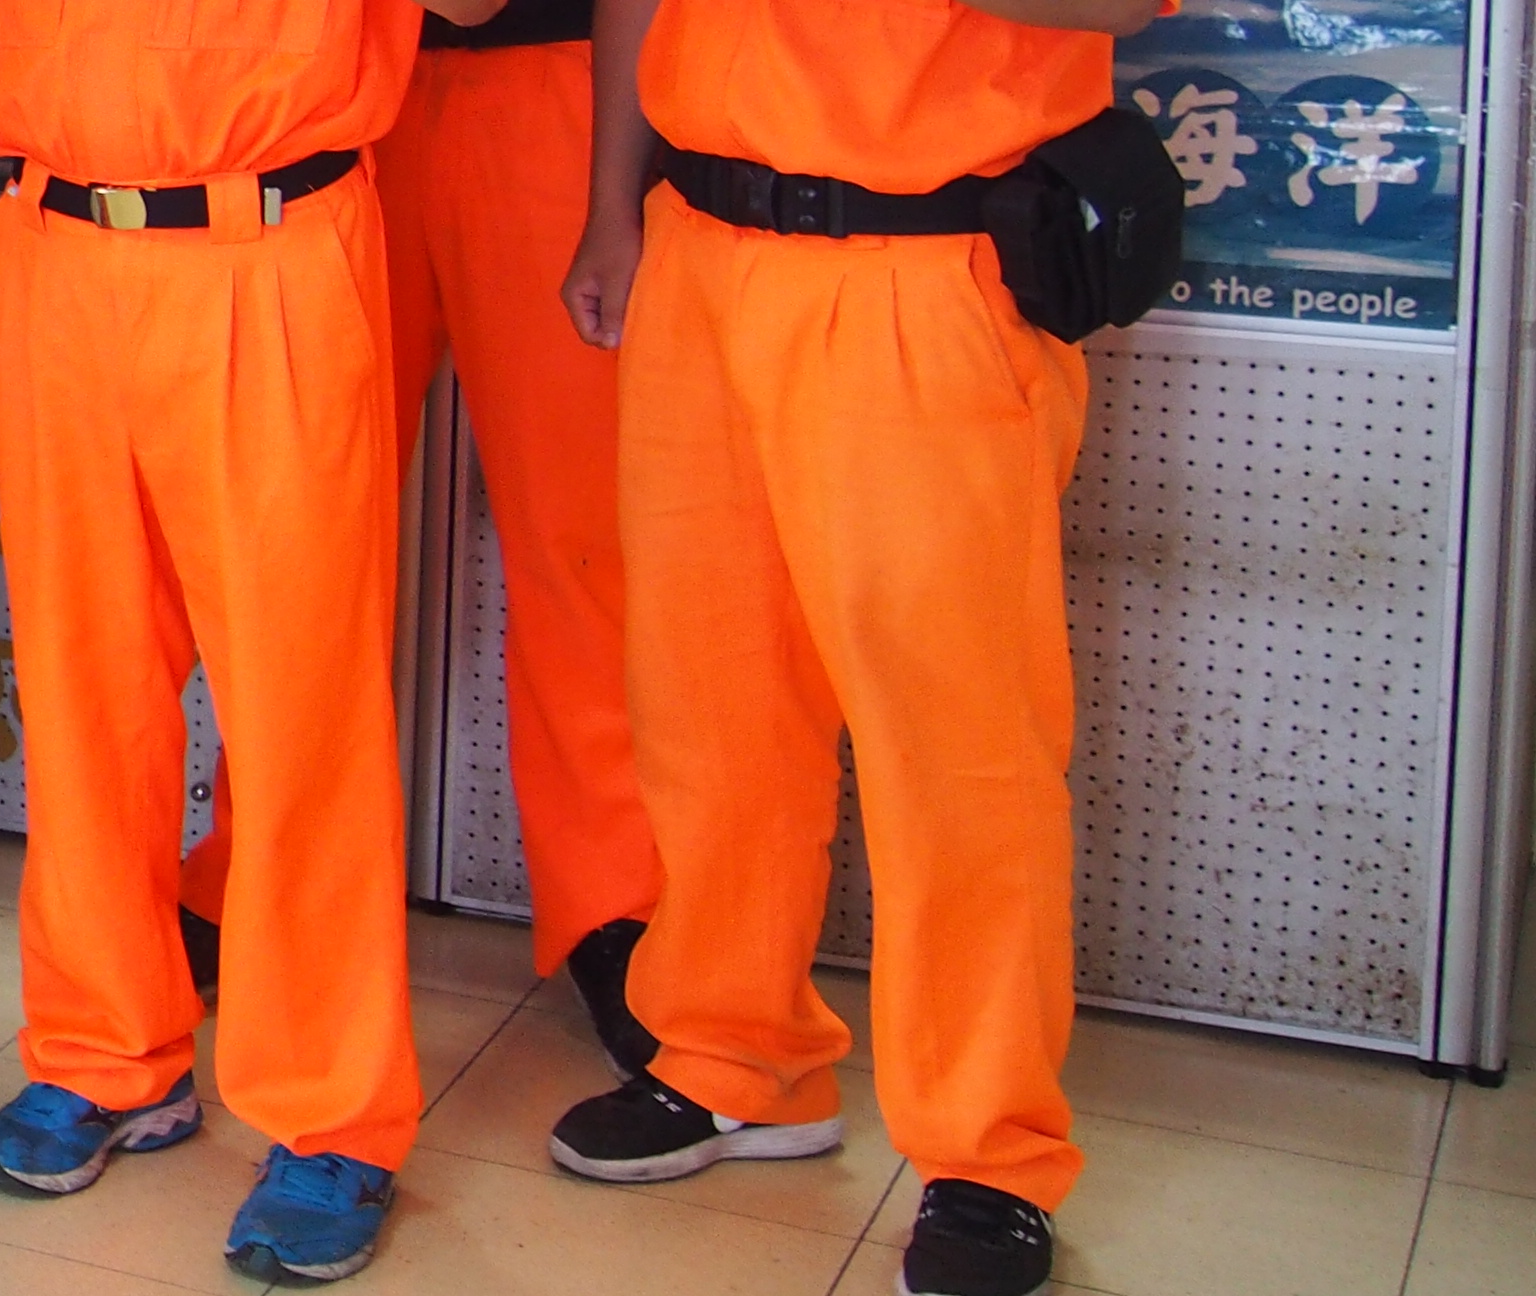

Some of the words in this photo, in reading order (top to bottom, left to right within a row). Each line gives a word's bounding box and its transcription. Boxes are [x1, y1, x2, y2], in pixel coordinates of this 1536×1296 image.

[1131, 84, 1419, 226] 海洋
[1209, 275, 1275, 308] the
[1292, 286, 1417, 324] people
